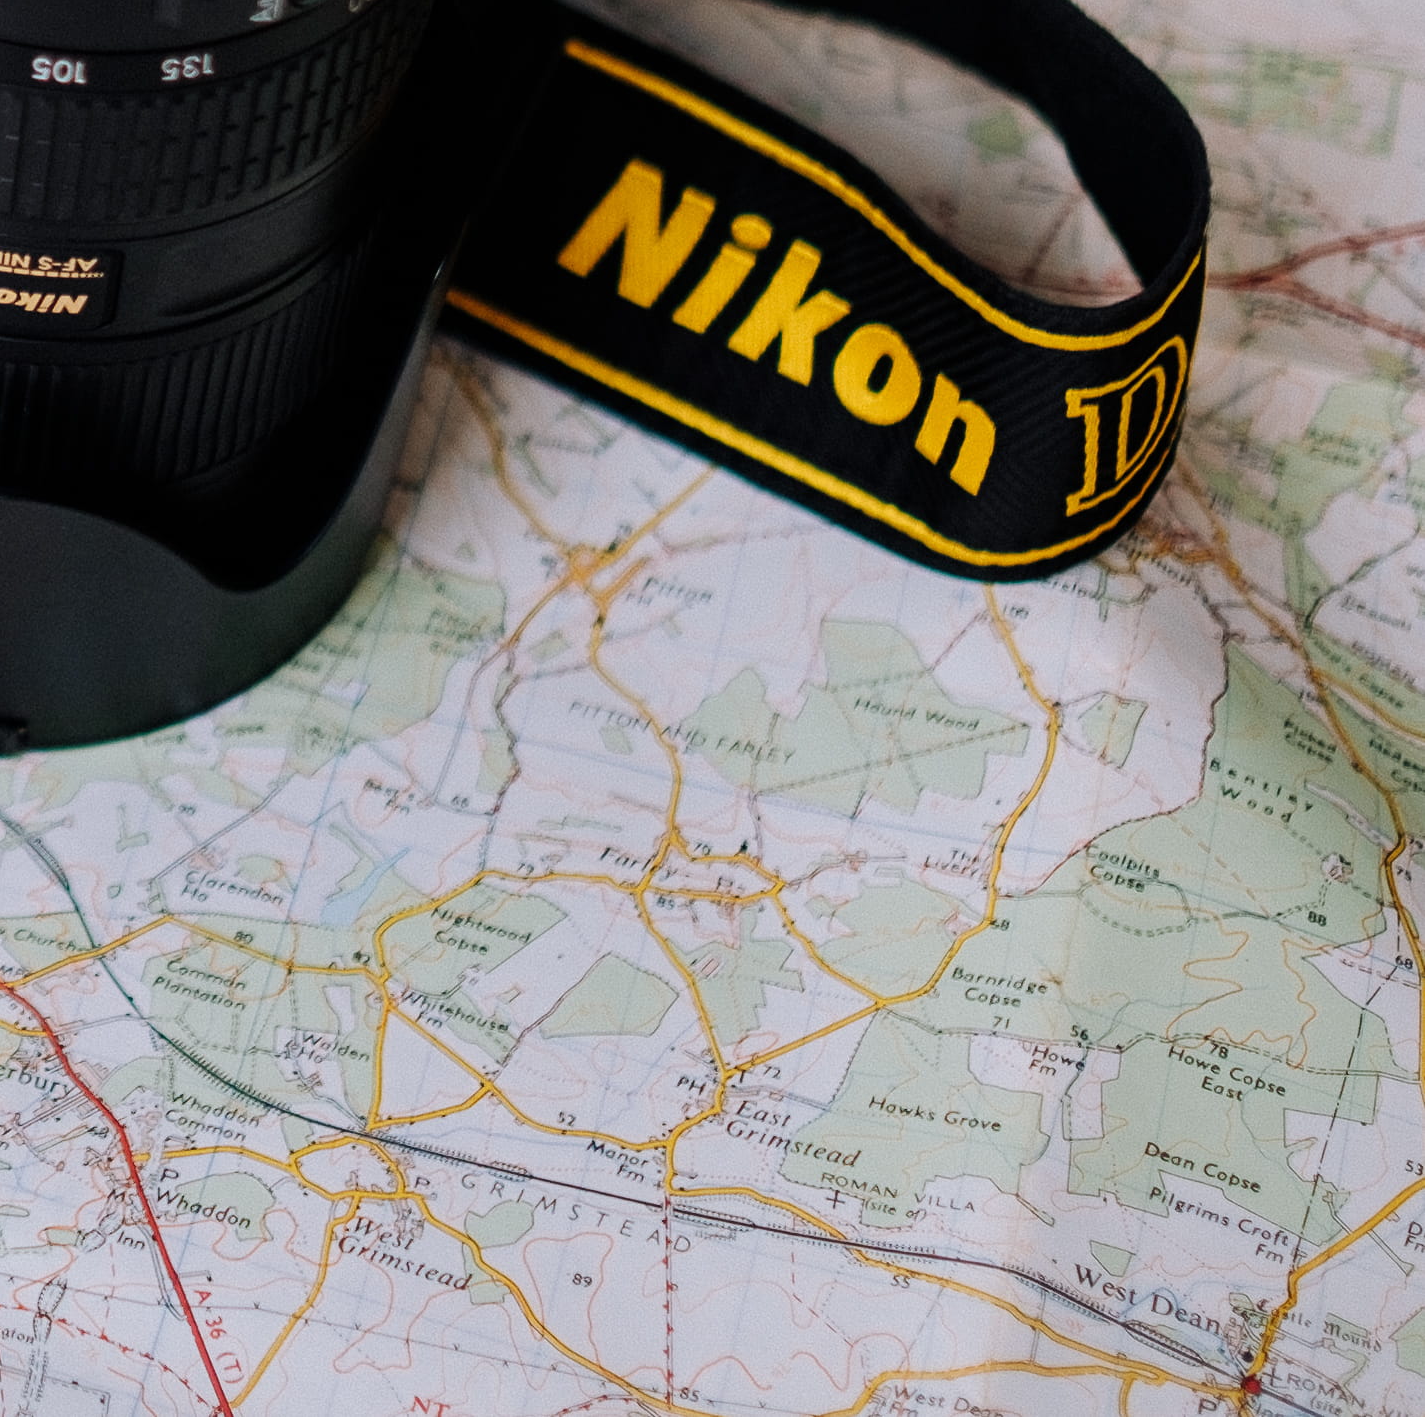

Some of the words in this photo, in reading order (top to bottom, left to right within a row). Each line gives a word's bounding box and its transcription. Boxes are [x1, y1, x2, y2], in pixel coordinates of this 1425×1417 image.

[31, 55, 88, 86] 105
[161, 52, 215, 82] 135
[38, 256, 99, 273] AF-S
[557, 158, 997, 498] Nikon
[854, 698, 918, 722] Hound
[924, 709, 981, 732] Wood
[717, 733, 796, 766] FARLEY
[1210, 756, 1316, 813] Bentley
[1221, 785, 1294, 825] Wood
[1086, 844, 1161, 879] Coalpits
[185, 868, 285, 907] Clarendon
[1089, 864, 1146, 892] Copse
[431, 903, 533, 945] Nightwood
[436, 929, 490, 955] Copse
[166, 961, 246, 991] Common
[951, 967, 1050, 996] Barnridge
[152, 976, 246, 1011] Plantation
[965, 988, 1022, 1009] Copse
[401, 989, 510, 1033] Whitehouse
[417, 1010, 443, 1029] Fm
[302, 1032, 370, 1061] Walden
[1071, 1025, 1089, 1040] 56
[1033, 1045, 1085, 1071] Howe
[1210, 1042, 1230, 1060] 78
[1029, 1059, 1057, 1077] Fm
[1168, 1046, 1222, 1077] Howe
[1226, 1065, 1287, 1098] Copse
[676, 1076, 705, 1095] PH
[1201, 1078, 1243, 1102] East
[172, 1093, 259, 1128] Whaddon
[557, 1113, 576, 1128] 52
[735, 1099, 792, 1129] East
[868, 1096, 937, 1123] Hawks
[944, 1109, 1002, 1134] Grove
[165, 1112, 246, 1142] Common
[586, 1139, 650, 1168] Manor
[725, 1121, 860, 1169] Grimstead
[617, 1163, 645, 1182] Fm
[1144, 1141, 1198, 1174] Dean
[1202, 1161, 1262, 1195] Copse
[820, 1172, 899, 1199] ROMAN
[914, 1193, 976, 1214] VILLA
[156, 1188, 251, 1230] Whaddon
[461, 1172, 693, 1254] GRIMSTEAD
[863, 1197, 898, 1220] (site
[1149, 1187, 1230, 1230] Pilgrims
[1238, 1215, 1291, 1247] Croft
[117, 1232, 146, 1252] Inn
[354, 1216, 415, 1251] West
[337, 1237, 474, 1292] Grimstead
[1255, 1242, 1285, 1264] Fm
[571, 1274, 593, 1288] 89
[890, 1276, 911, 1291] 55
[1073, 1264, 1138, 1308] West
[1151, 1298, 1222, 1337] Dean
[194, 1287, 213, 1306] A
[205, 1315, 225, 1341] 36
[217, 1350, 245, 1386] (T)
[1322, 1322, 1383, 1353] Mound
[679, 1387, 700, 1402] 85
[893, 1386, 945, 1411] West
[1285, 1372, 1368, 1411] ROMAN
